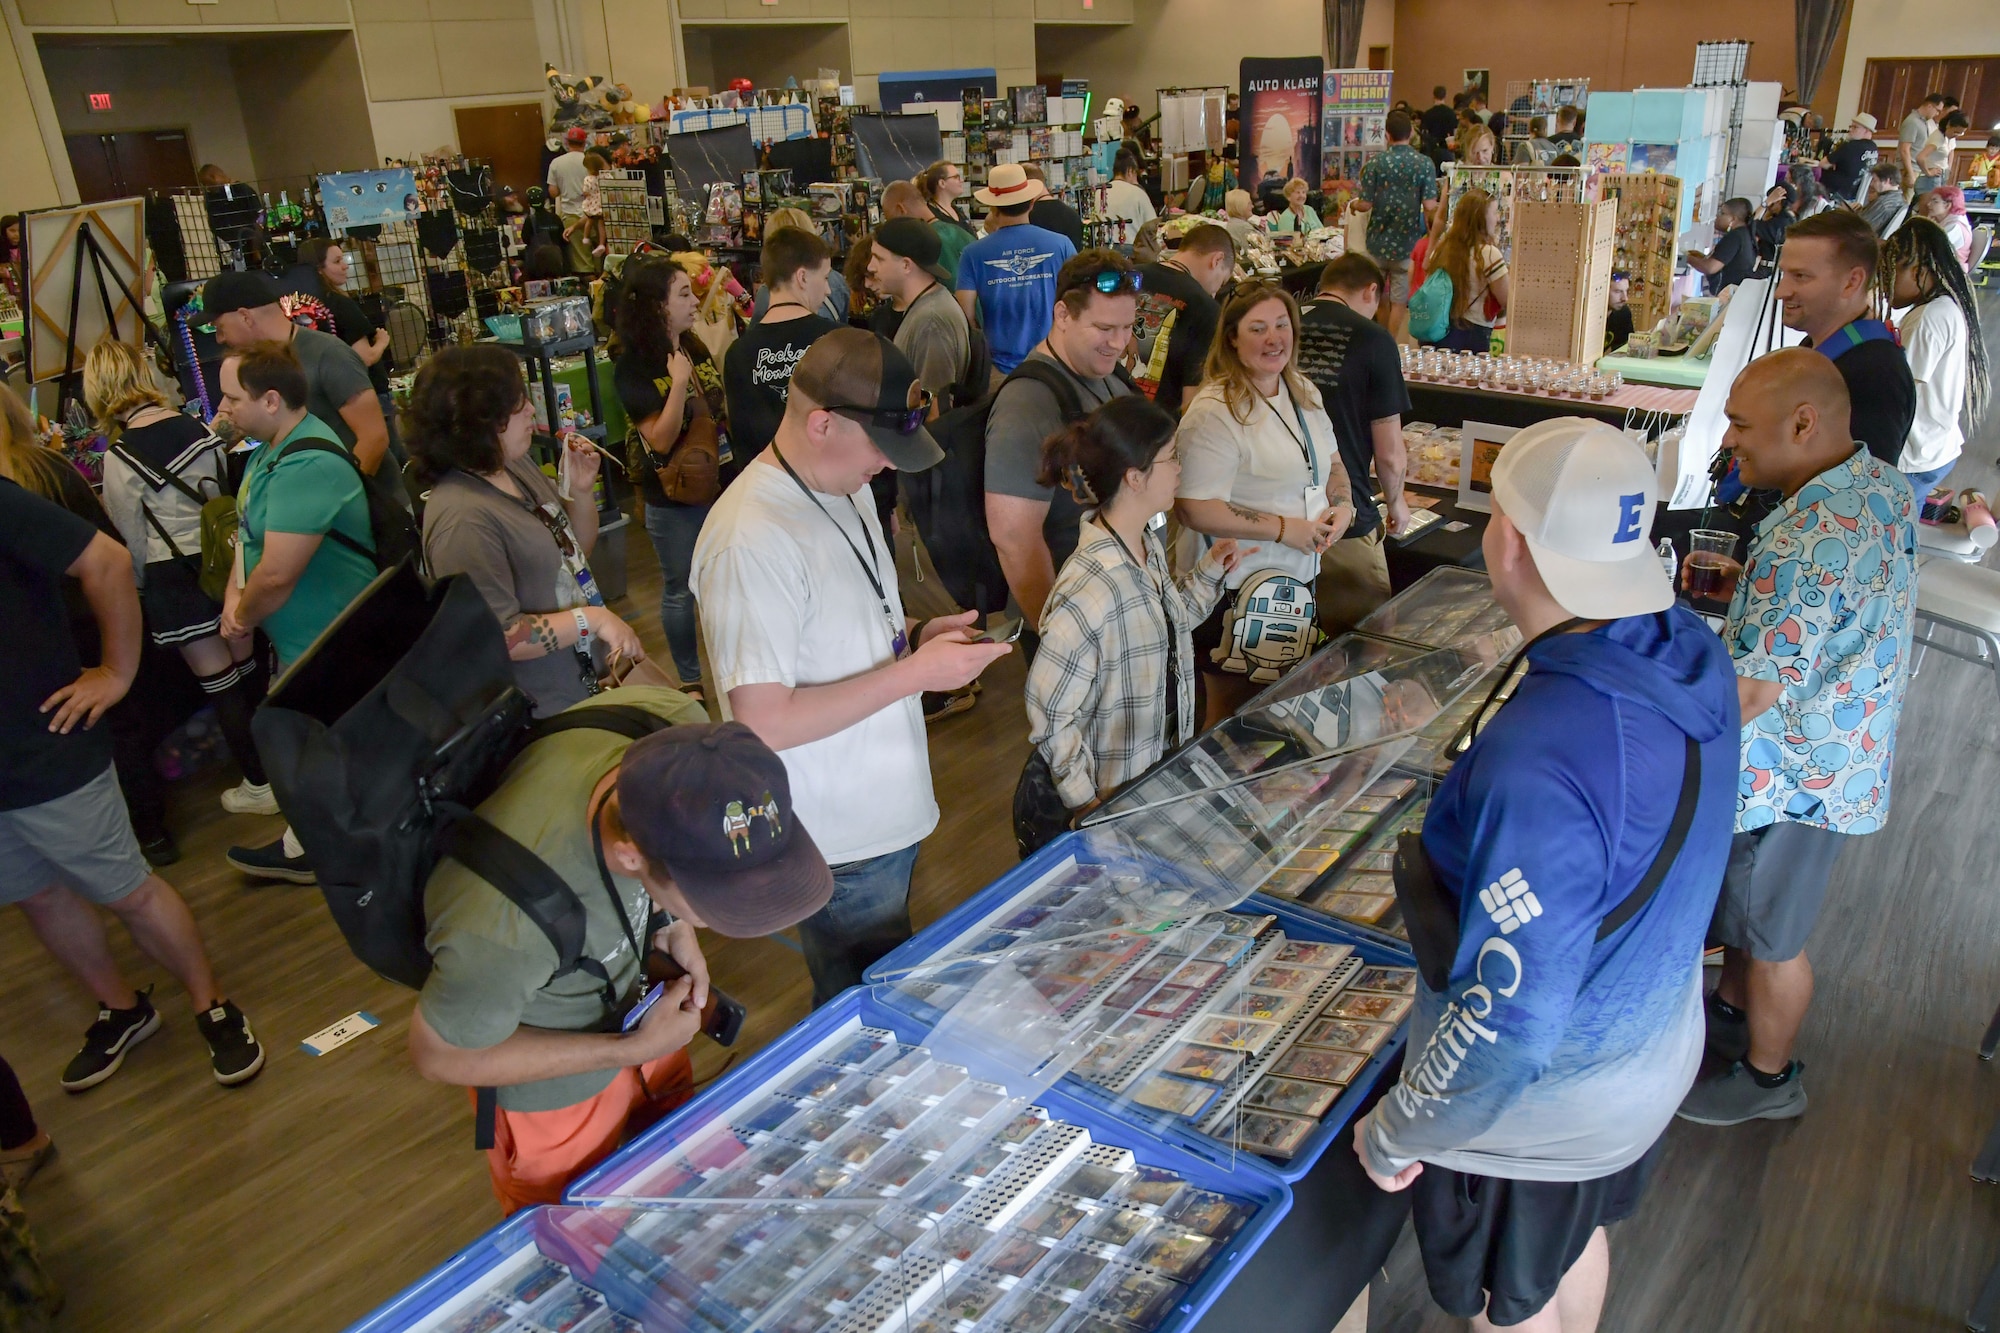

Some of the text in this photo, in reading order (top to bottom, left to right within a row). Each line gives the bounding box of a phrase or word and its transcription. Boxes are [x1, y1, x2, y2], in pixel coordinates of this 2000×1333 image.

[1248, 77, 1319, 92] AUTO KLASH
[1341, 73, 1379, 86] CHARLES
[1341, 87, 1390, 99] MOISANT
[89, 93, 112, 110] EXIT
[1014, 247, 1035, 255] FORCE
[987, 272, 1053, 286] OUTDOOR RECREATION
[756, 342, 811, 369] Pocke
[752, 361, 798, 385] Mons
[1612, 491, 1645, 544] E
[333, 1028, 347, 1037] 25
[1395, 936, 1522, 1118] Columbia
